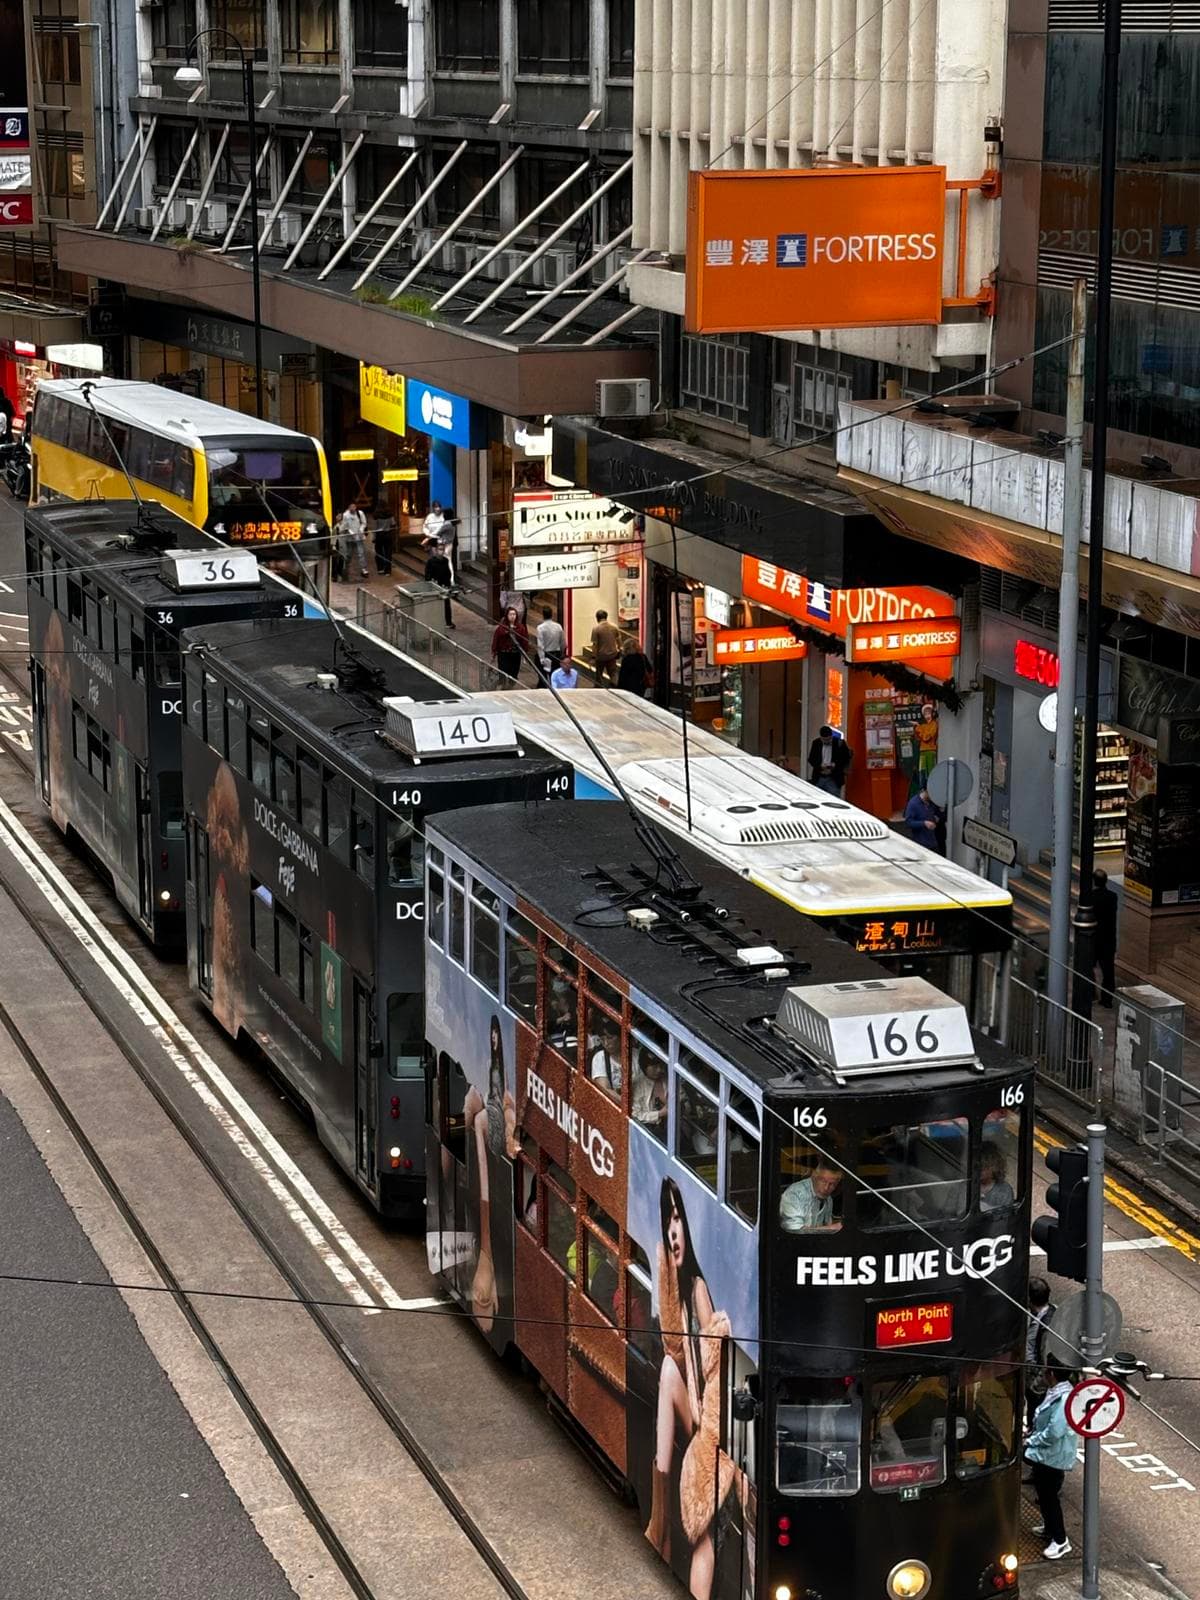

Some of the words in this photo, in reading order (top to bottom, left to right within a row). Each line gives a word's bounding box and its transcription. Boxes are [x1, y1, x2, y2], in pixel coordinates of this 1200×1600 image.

[705, 238, 769, 266] 豐澤
[813, 233, 937, 264] FORTRESS
[201, 560, 235, 581] 36
[157, 611, 173, 624] 36
[284, 604, 298, 617] 36
[902, 631, 957, 647] FORTRESS
[438, 716, 491, 746] 140
[546, 776, 568, 793] 140
[392, 790, 422, 805] 140
[866, 1014, 939, 1059] 166
[1001, 1083, 1024, 1107] 166
[527, 1067, 555, 1121] FEELS
[557, 1095, 578, 1144] LIKE
[580, 1117, 614, 1178] UGG
[793, 1107, 827, 1128] 166
[796, 1255, 877, 1286] FEELS
[884, 1249, 939, 1284] LIKE
[877, 1309, 914, 1325] North
[918, 1304, 949, 1320] Point
[893, 1322, 933, 1338] 北角
[1100, 1441, 1196, 1491] LEFT
